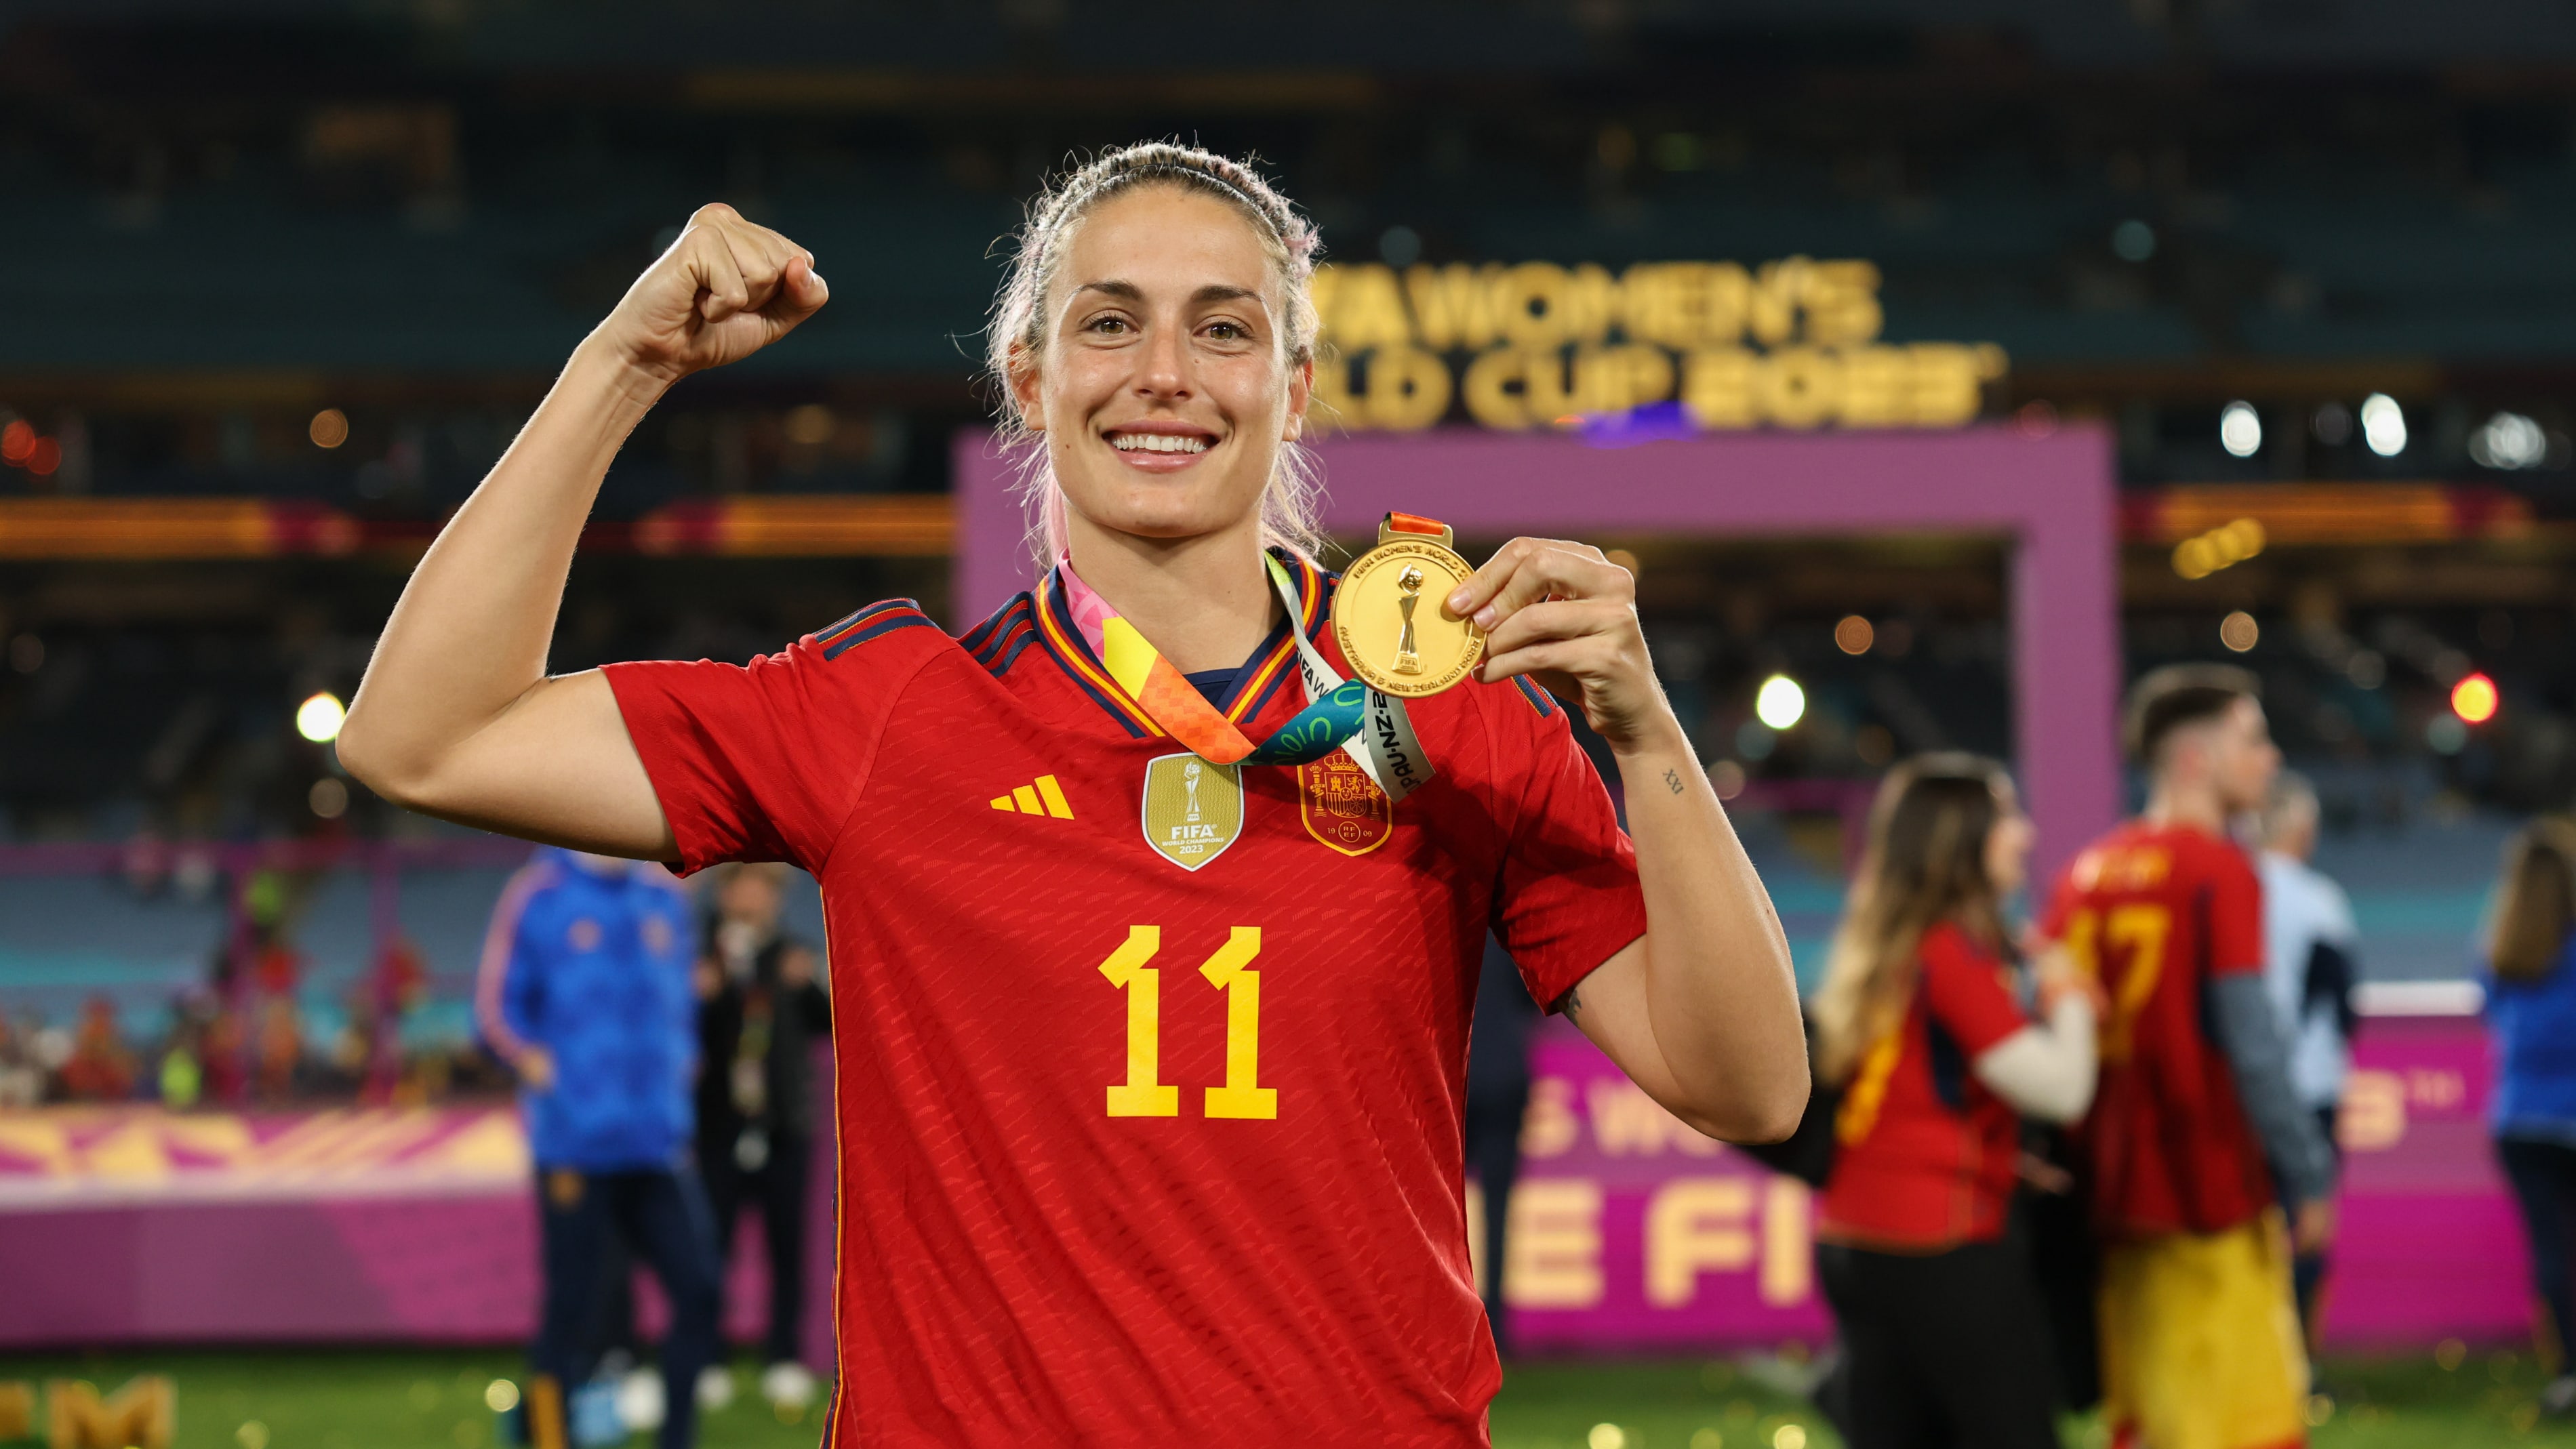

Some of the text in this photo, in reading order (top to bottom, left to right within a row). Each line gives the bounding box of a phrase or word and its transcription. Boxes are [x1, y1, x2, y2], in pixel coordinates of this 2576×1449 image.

[1464, 346, 1674, 430] CUP
[1373, 544, 1423, 561] WOMEN'S
[1424, 546, 1459, 570] WORLD
[1339, 624, 1377, 681] AUSTRALIA
[1386, 680, 1413, 693] NEW
[1413, 669, 1460, 693] ZEALAND
[1662, 769, 1684, 794] XXI
[1180, 845, 1204, 854] 2023
[1098, 925, 1277, 1120] 11
[1645, 1176, 1813, 1305] FI
